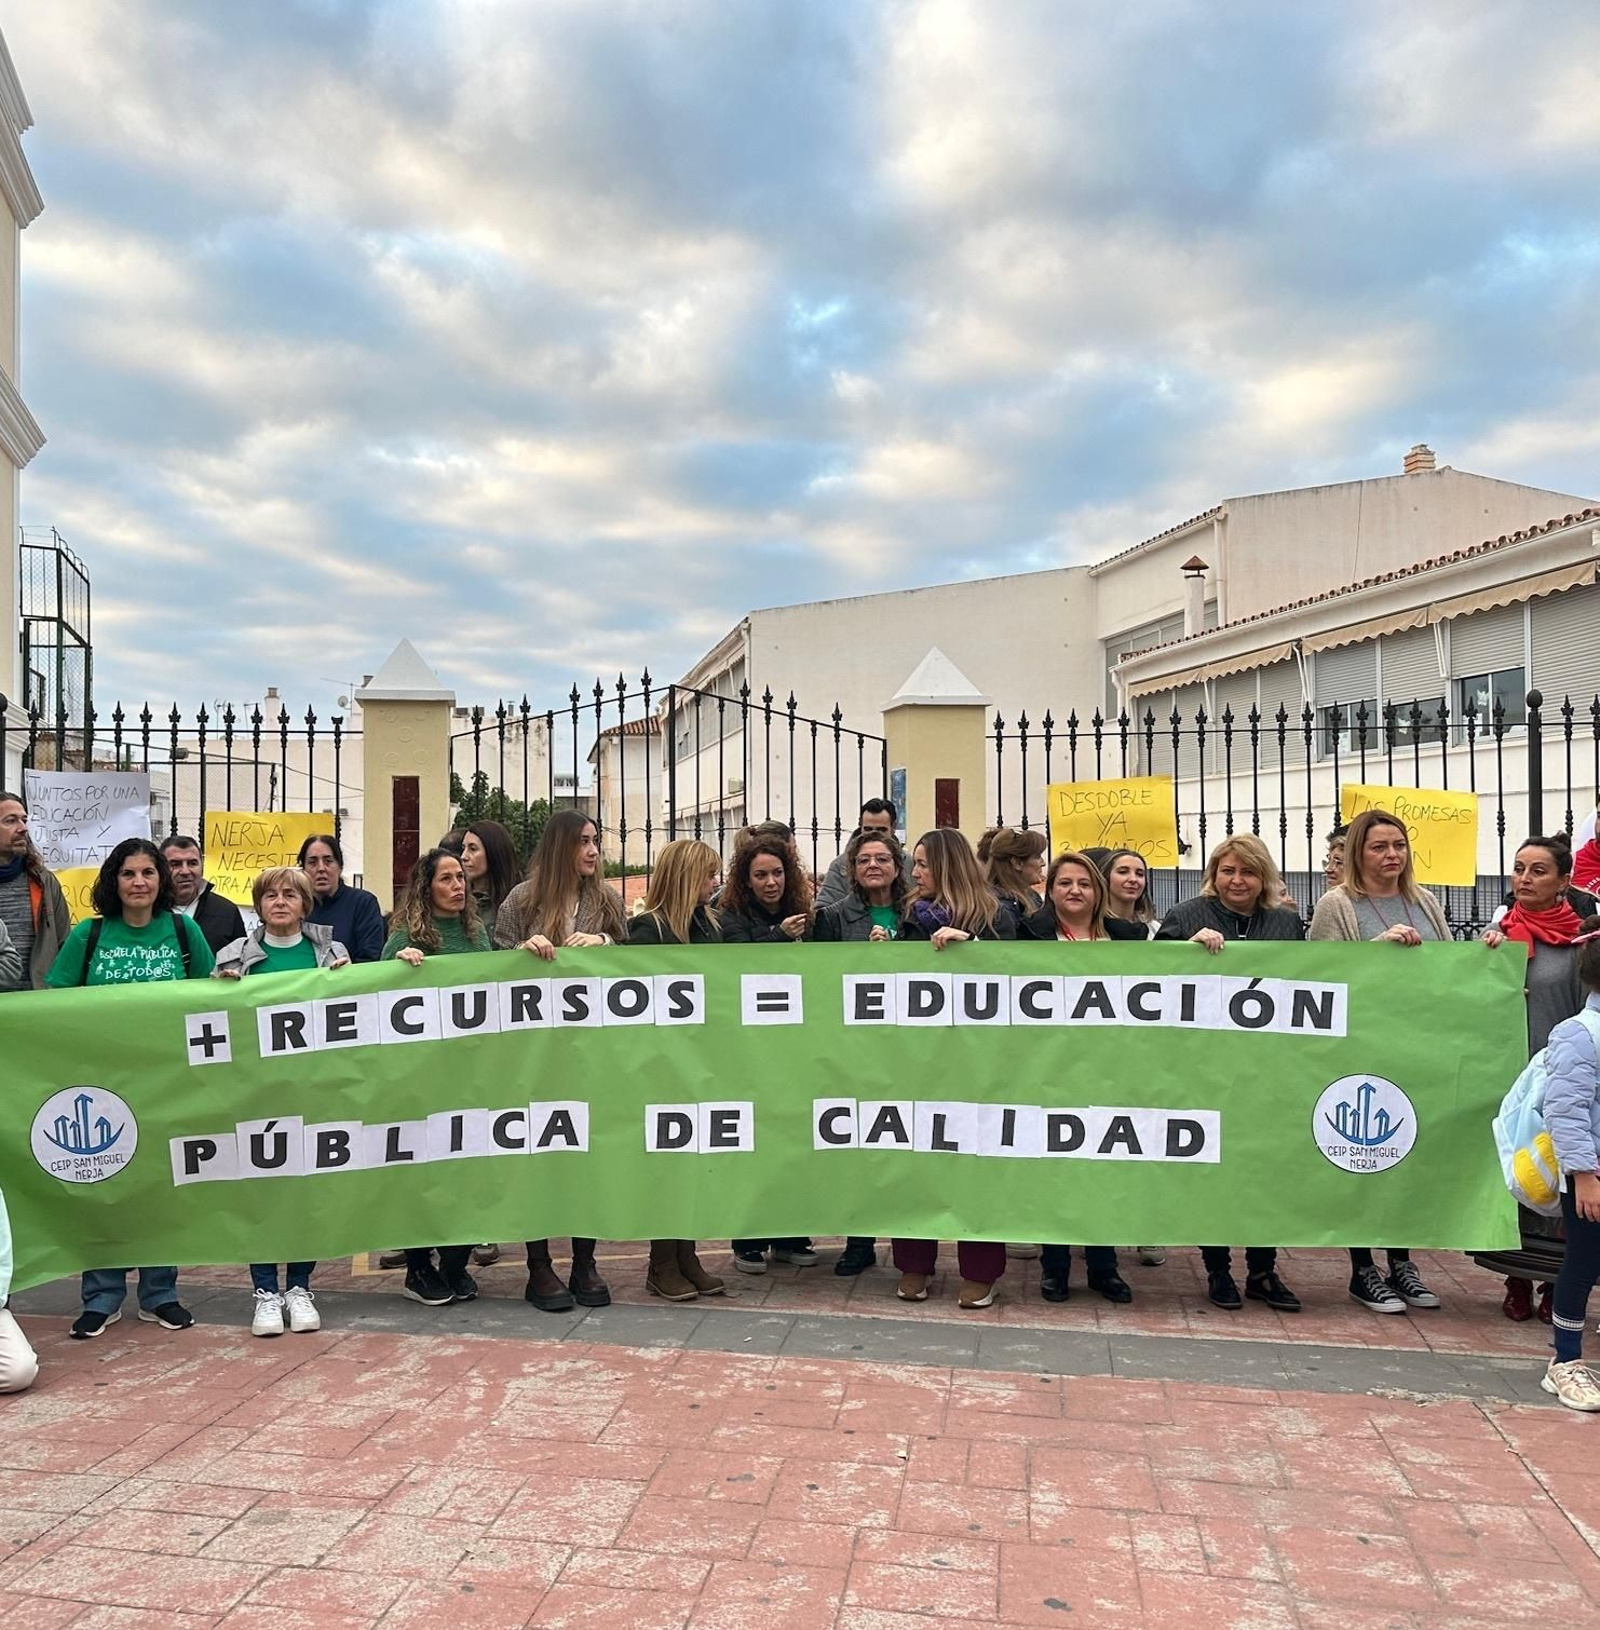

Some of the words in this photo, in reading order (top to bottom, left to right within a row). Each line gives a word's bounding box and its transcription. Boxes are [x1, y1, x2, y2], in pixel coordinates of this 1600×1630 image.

[86, 785, 109, 800] POR
[112, 786, 140, 800] UNA
[1059, 788, 1154, 817] DESDOBLE
[1394, 795, 1473, 825] PROMESAS
[30, 802, 110, 823] EDUCACIÓN
[97, 825, 112, 839] Y
[211, 821, 285, 847] NERJA
[1096, 810, 1128, 841] YA
[42, 845, 115, 864] EQUITAT
[217, 852, 299, 872] NECESIT
[209, 875, 241, 893] OTRA
[99, 947, 138, 960] ESCUELA
[105, 968, 122, 980] DE
[127, 966, 172, 978] TOD@S
[270, 979, 695, 1052] RECURSOS
[854, 977, 1335, 1030] EDUCACIÓN
[183, 1110, 580, 1175] PÚBLICA
[656, 1110, 741, 1149] DE
[818, 1105, 1205, 1157] CALIDAD
[1327, 1145, 1347, 1157] CEIP
[1349, 1146, 1368, 1157] SAN
[1369, 1147, 1401, 1159] MIGUEL
[50, 1158, 72, 1172] CEIP
[73, 1157, 92, 1169] SAN
[93, 1153, 126, 1167] MIGUEL
[1350, 1159, 1377, 1170] NERJA
[75, 1168, 104, 1180] NERJA
